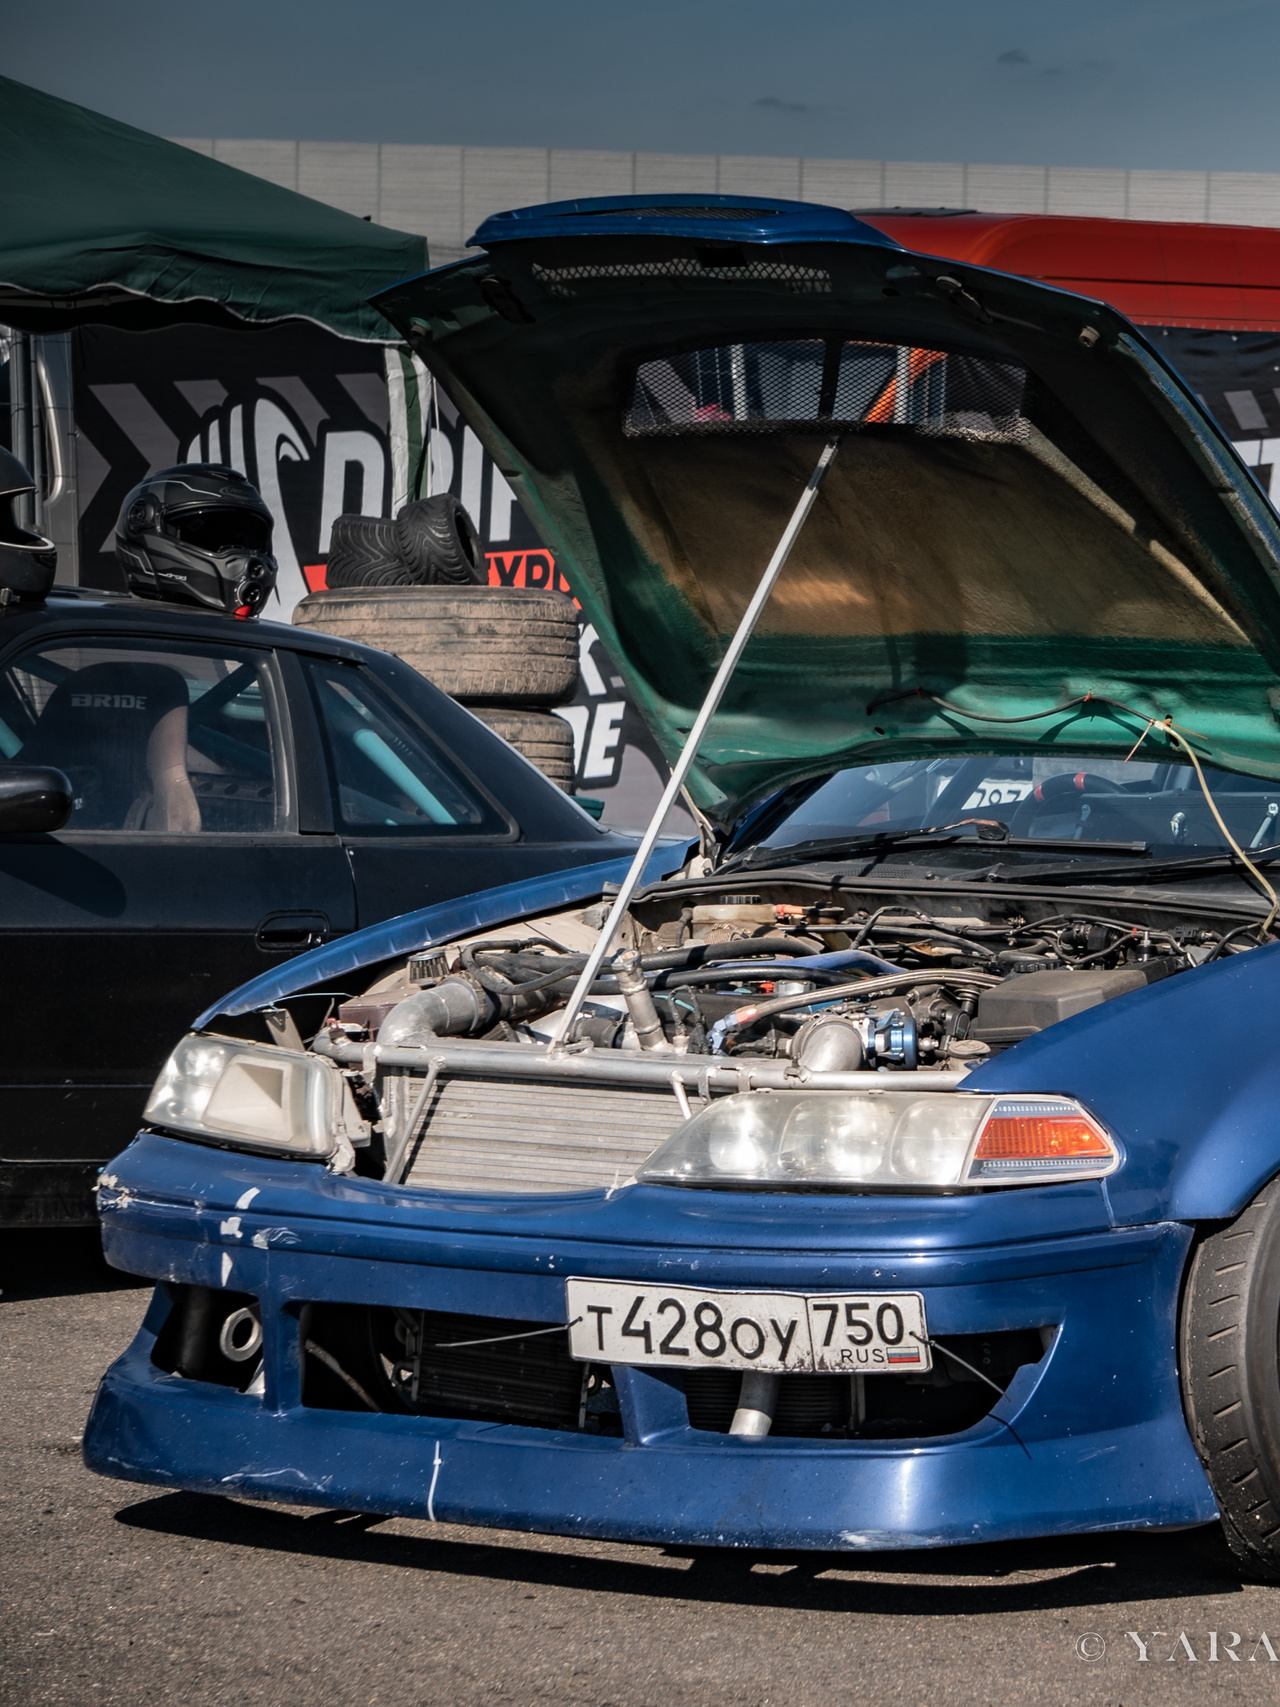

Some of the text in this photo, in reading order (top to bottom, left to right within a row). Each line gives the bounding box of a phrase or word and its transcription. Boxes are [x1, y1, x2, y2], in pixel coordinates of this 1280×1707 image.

[71, 694, 148, 710] BRIDE
[812, 1302, 905, 1347] 750
[841, 1348, 885, 1364] RUS
